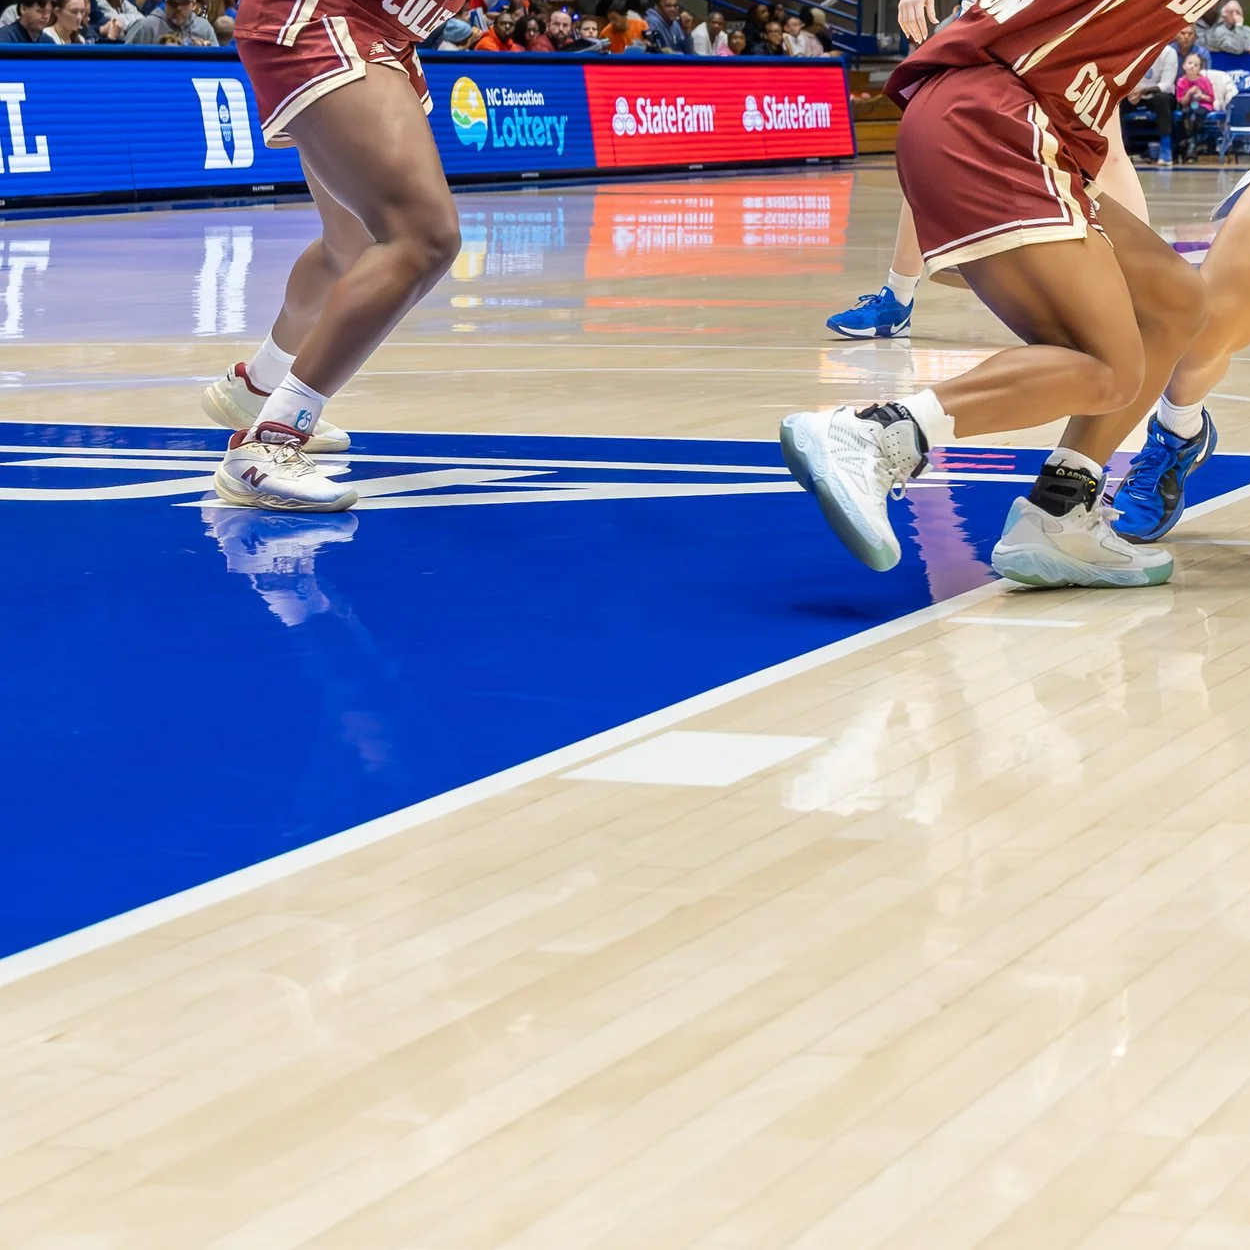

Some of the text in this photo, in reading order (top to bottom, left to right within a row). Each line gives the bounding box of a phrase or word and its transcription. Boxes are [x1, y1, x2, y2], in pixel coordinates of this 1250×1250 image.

[486, 88, 545, 107] NC Education
[0, 82, 51, 174] L
[489, 107, 567, 156] Lottery
